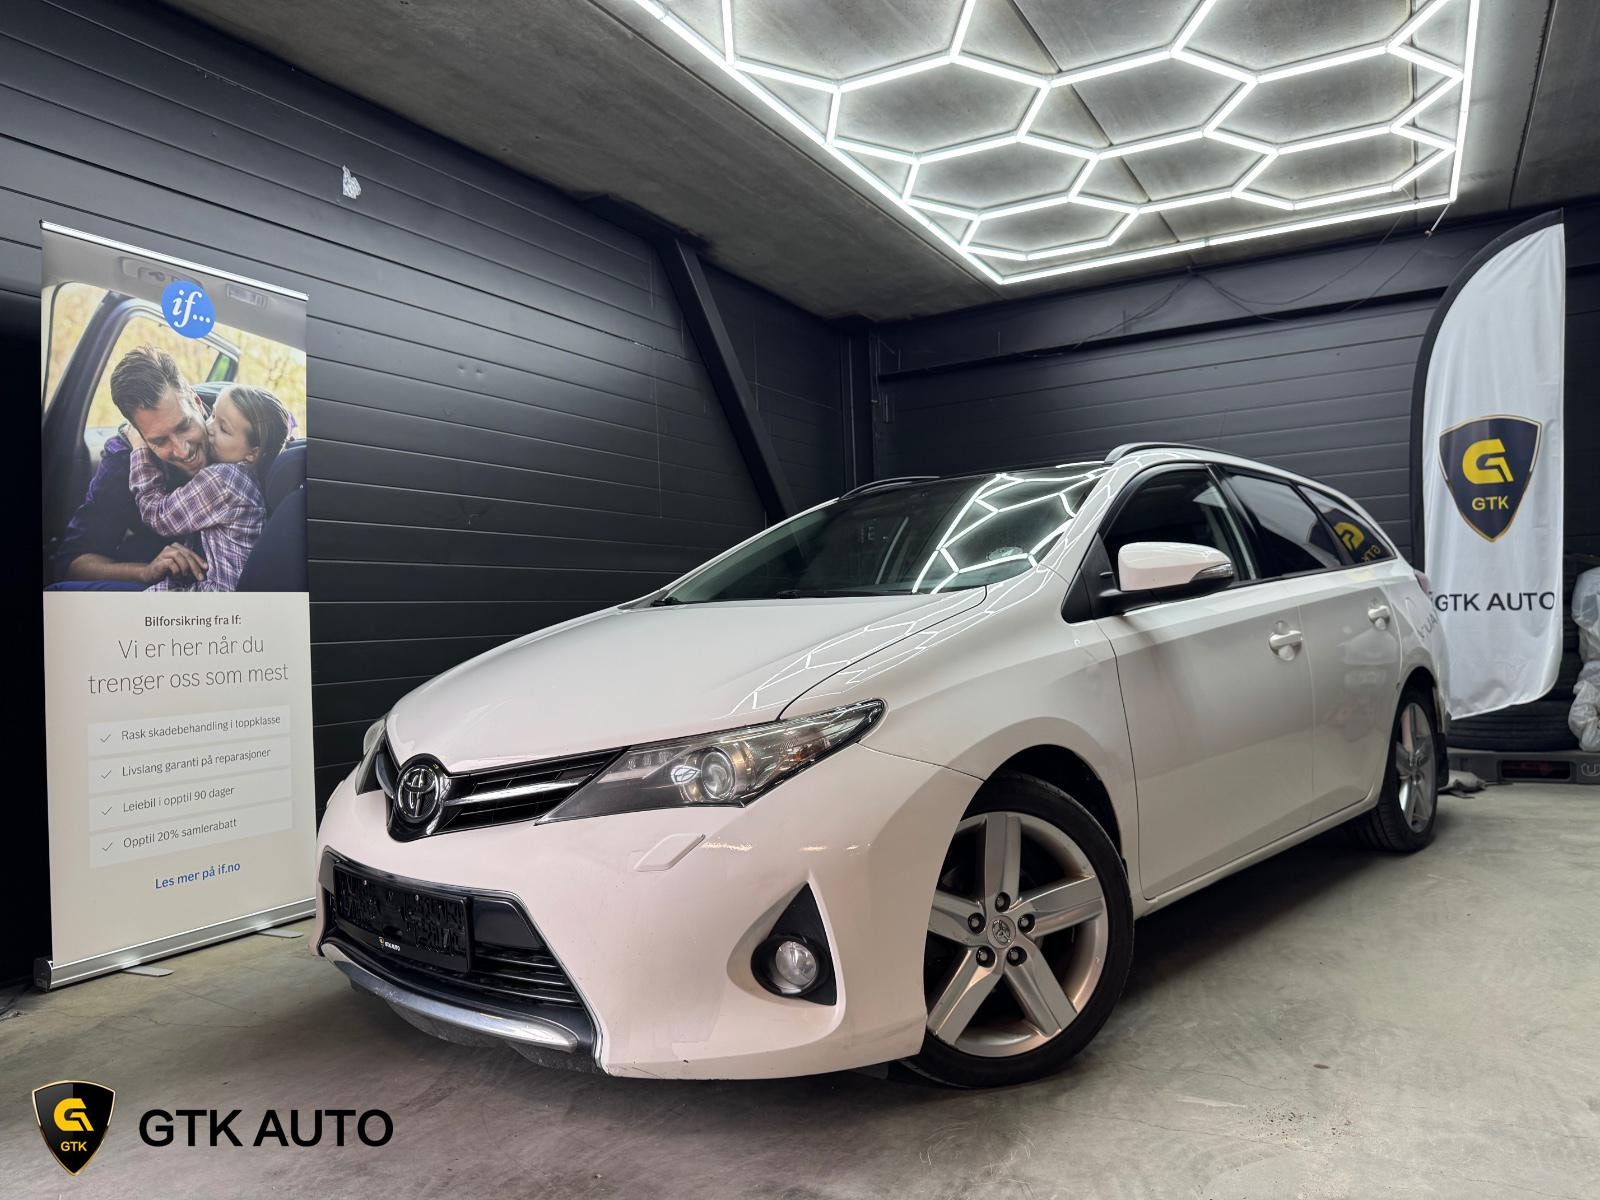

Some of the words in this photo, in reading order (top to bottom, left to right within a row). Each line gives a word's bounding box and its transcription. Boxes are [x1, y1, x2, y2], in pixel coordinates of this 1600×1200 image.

[1471, 496, 1510, 511] GTK
[1435, 593, 1480, 612] GTK
[1486, 591, 1555, 611] AUTO
[145, 616, 212, 628] Bilforsikring
[213, 616, 230, 626] fra
[119, 639, 138, 659] Vi
[145, 641, 165, 658] er
[171, 637, 203, 657] her
[207, 635, 238, 656] når
[242, 635, 265, 655] du
[88, 673, 165, 695] trenger
[170, 673, 200, 688] oss
[206, 670, 243, 685] som
[248, 664, 289, 683] mest
[121, 730, 146, 741] Rask
[148, 721, 229, 738] skadebehandling
[235, 715, 281, 728] toppklasse
[122, 764, 163, 777] Livslang
[165, 759, 199, 773] garanti
[200, 755, 214, 768] på
[215, 748, 271, 763] reparasjoner
[123, 798, 156, 813] Leiebil
[163, 793, 192, 807] opptil
[193, 791, 208, 802] 90
[208, 787, 235, 801] dager
[122, 834, 156, 850] Opptil
[156, 830, 180, 843] 20%
[181, 819, 238, 837] samlerabatt
[154, 877, 176, 891] Les
[176, 873, 200, 885] mer
[201, 866, 217, 881] på
[217, 863, 242, 877] if.no
